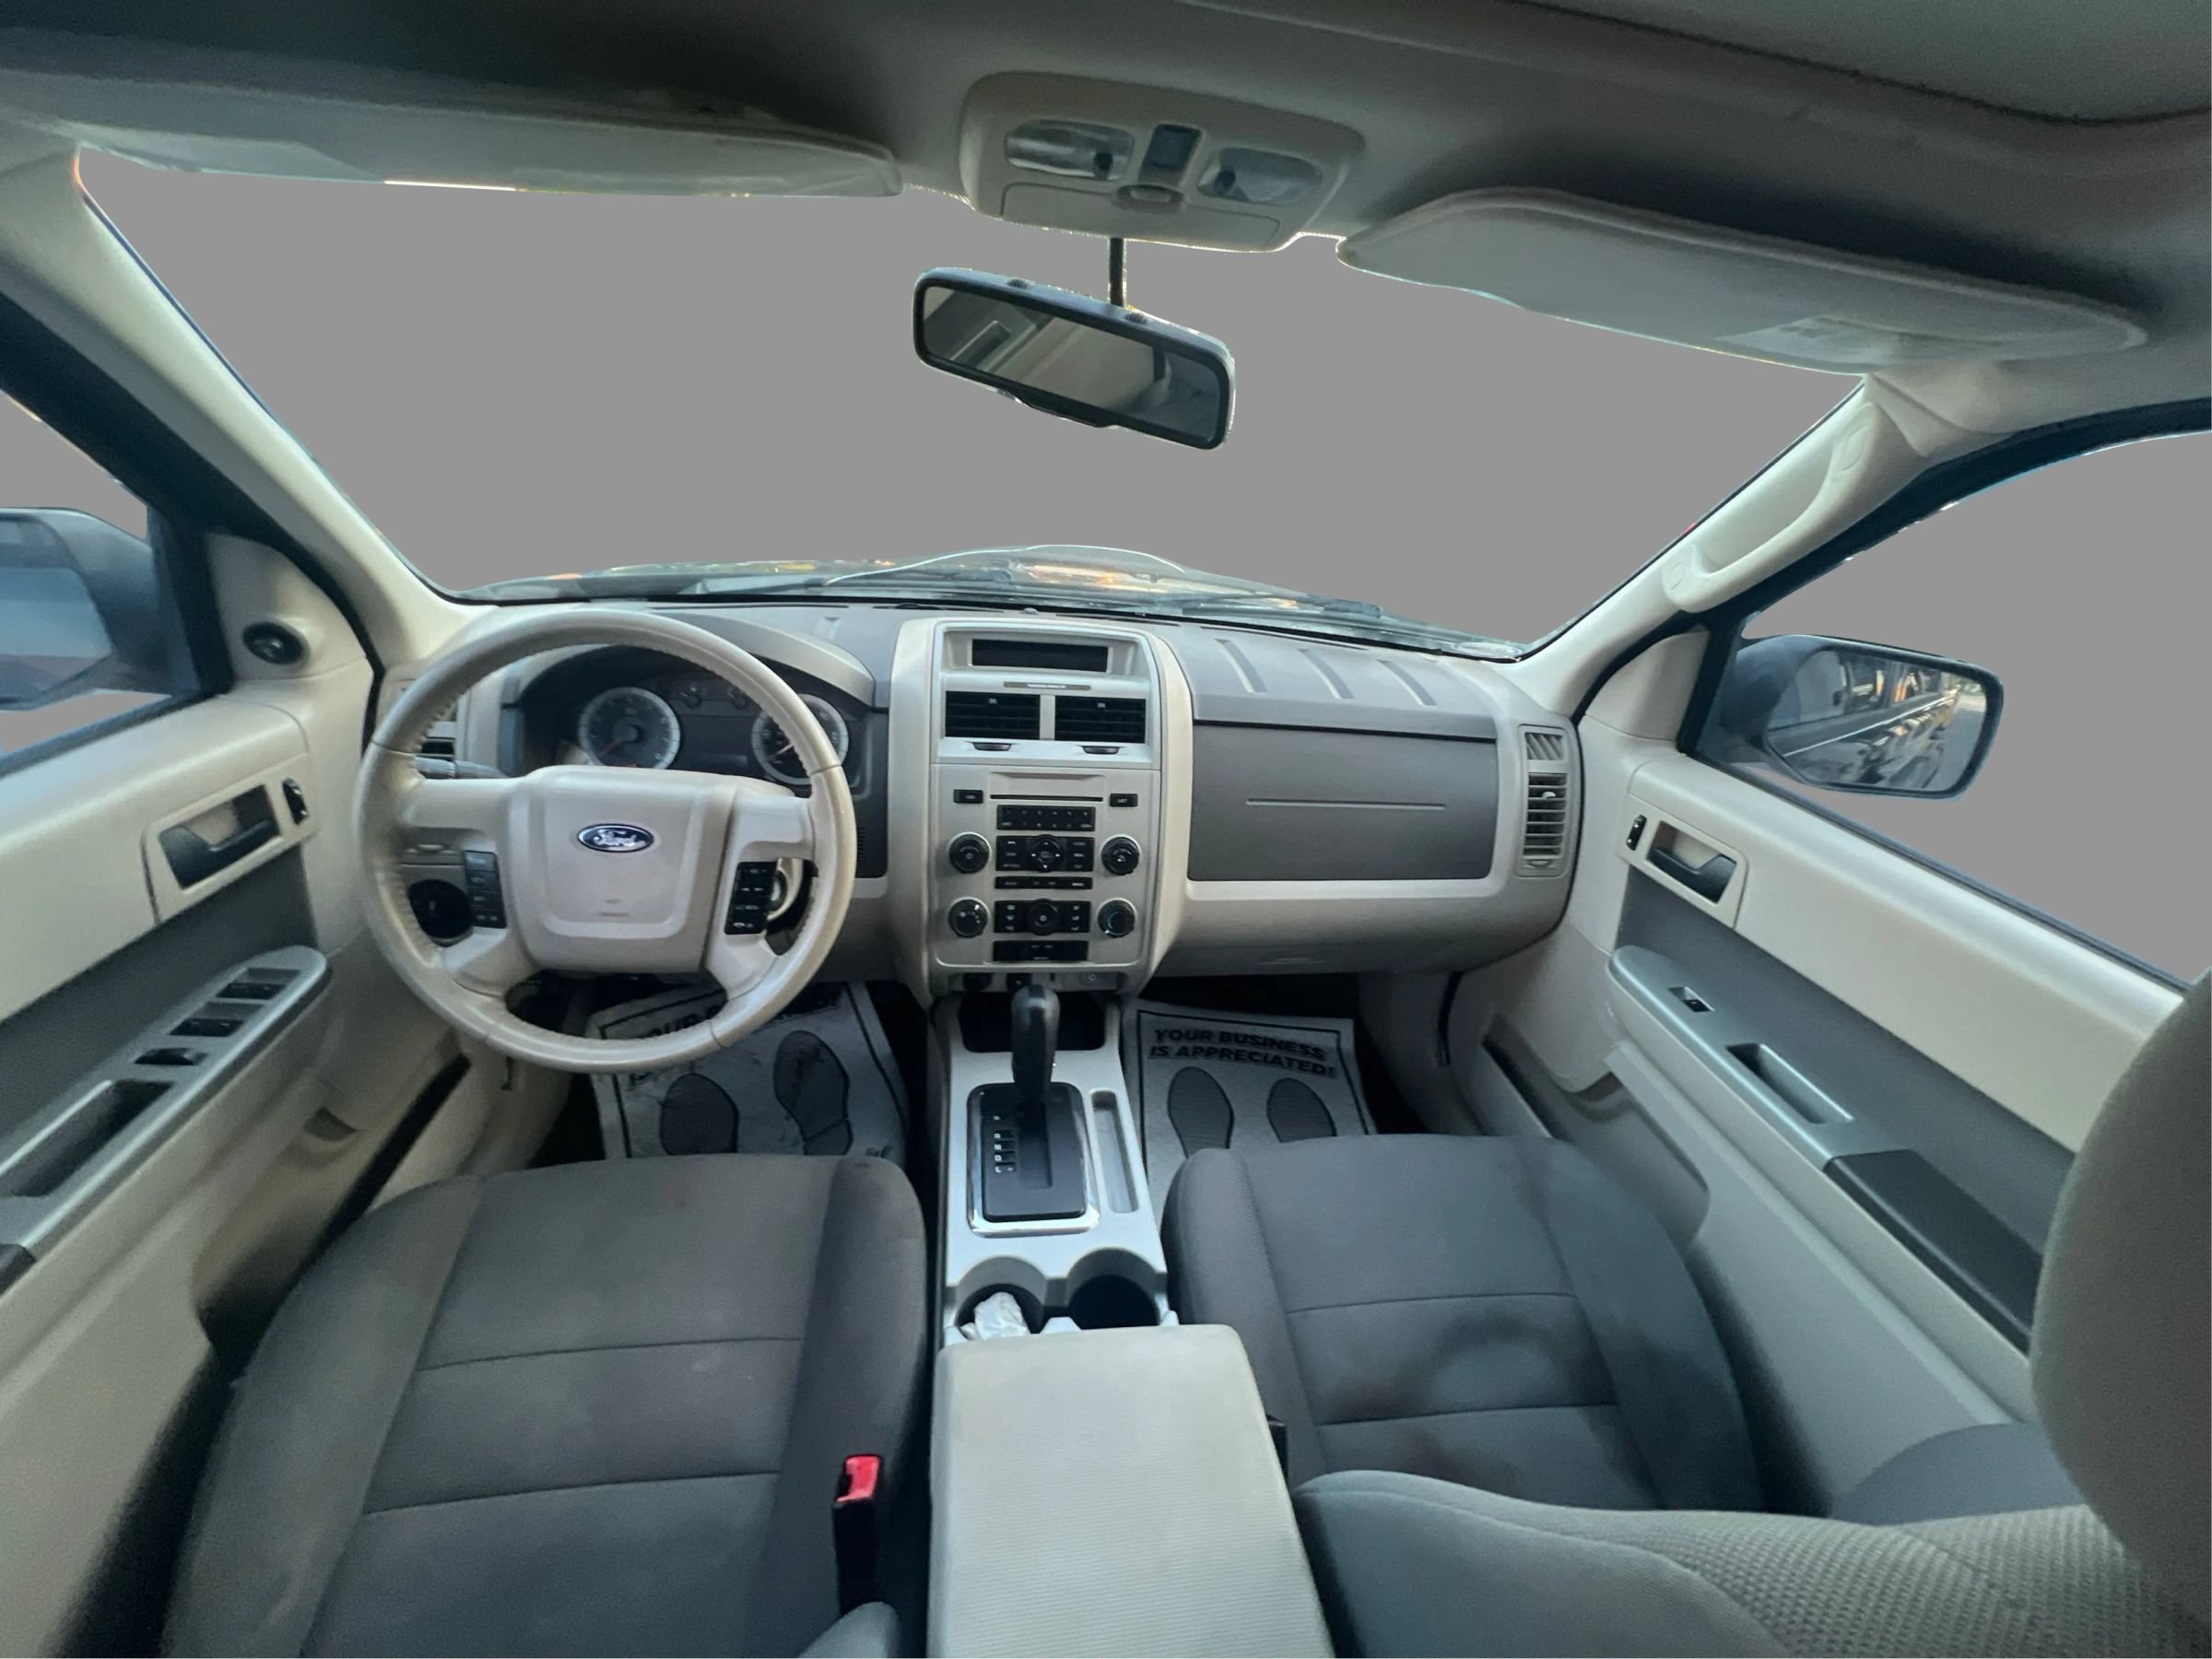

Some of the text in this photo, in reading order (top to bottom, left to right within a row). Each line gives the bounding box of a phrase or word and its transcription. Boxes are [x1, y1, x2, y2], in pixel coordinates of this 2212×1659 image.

[1149, 1045, 1337, 1077] IS APPRECIATED!
[1154, 1029, 1327, 1062] YOUR BUSINESS
